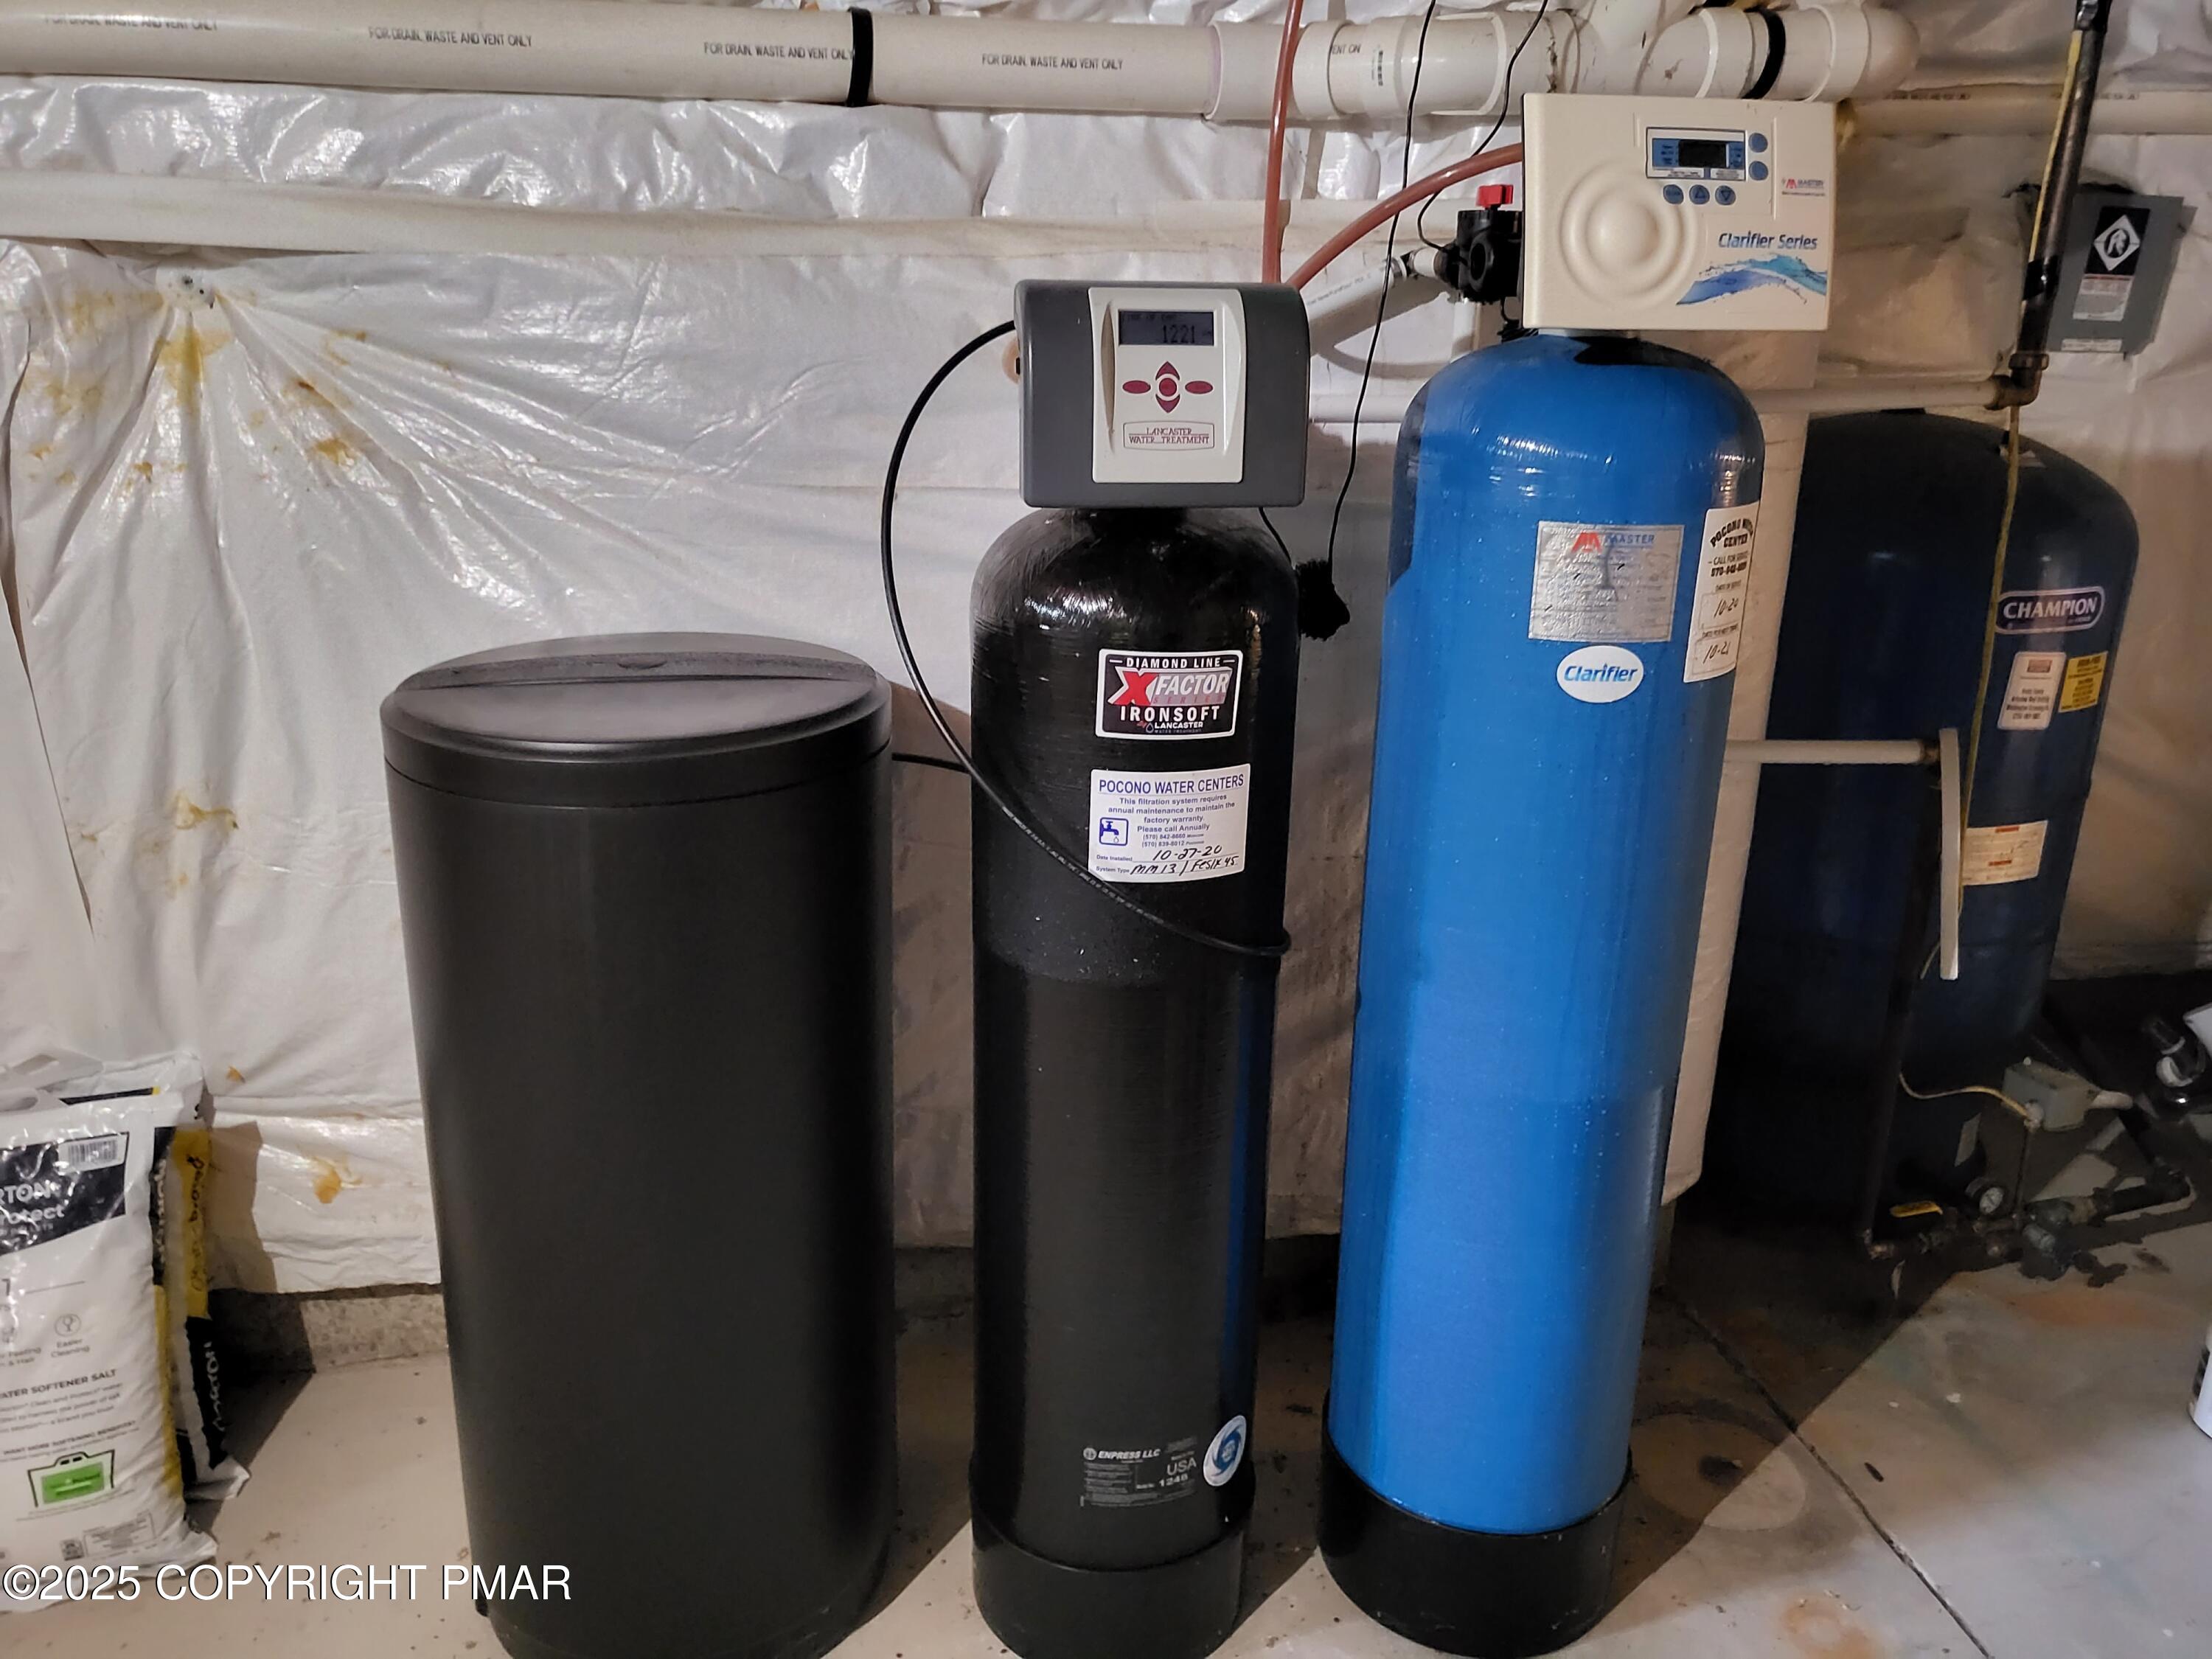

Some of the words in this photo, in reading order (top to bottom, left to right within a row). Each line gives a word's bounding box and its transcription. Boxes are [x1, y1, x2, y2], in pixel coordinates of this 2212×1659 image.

[425, 30, 457, 44] WASTE
[461, 32, 479, 45] AND
[483, 33, 504, 46] VENT
[508, 34, 532, 47] ONLY
[703, 42, 723, 54] FOR
[755, 45, 785, 58] WASTE
[788, 46, 805, 59] AND
[808, 47, 828, 60] VENT
[981, 54, 999, 66] FOR
[1030, 55, 1057, 68] WASTE
[1060, 56, 1077, 69] AND
[1079, 58, 1099, 70] VENT
[1102, 58, 1123, 71] ONLY
[1719, 231, 1774, 249] Clarifier
[1778, 234, 1818, 250] Series
[1129, 436, 1155, 444] WATER
[1161, 435, 1209, 444] TREATMENT
[1147, 428, 1192, 436] LANCASTER
[2003, 597, 2098, 619] CHAMPION
[1127, 657, 1187, 669] DIAMOND
[1194, 657, 1221, 667] LINE
[1564, 663, 1638, 682] Clarifier
[1120, 706, 1220, 722] IRONSOFT
[1099, 779, 1151, 793] POCONO
[1155, 780, 1194, 794] WATER
[1197, 773, 1244, 791] CENTERS
[1172, 797, 1197, 806] system
[1200, 793, 1227, 804] requires
[1195, 803, 1224, 812] maintain
[1144, 816, 1170, 824] factory
[1152, 845, 1222, 860] 10-27-20
[0, 1388, 28, 1399] ATER
[31, 1376, 88, 1394] SOFTENER
[91, 1368, 116, 1381] SALT
[1143, 1448, 1161, 1458] LLC
[1167, 1457, 1197, 1475] USA
